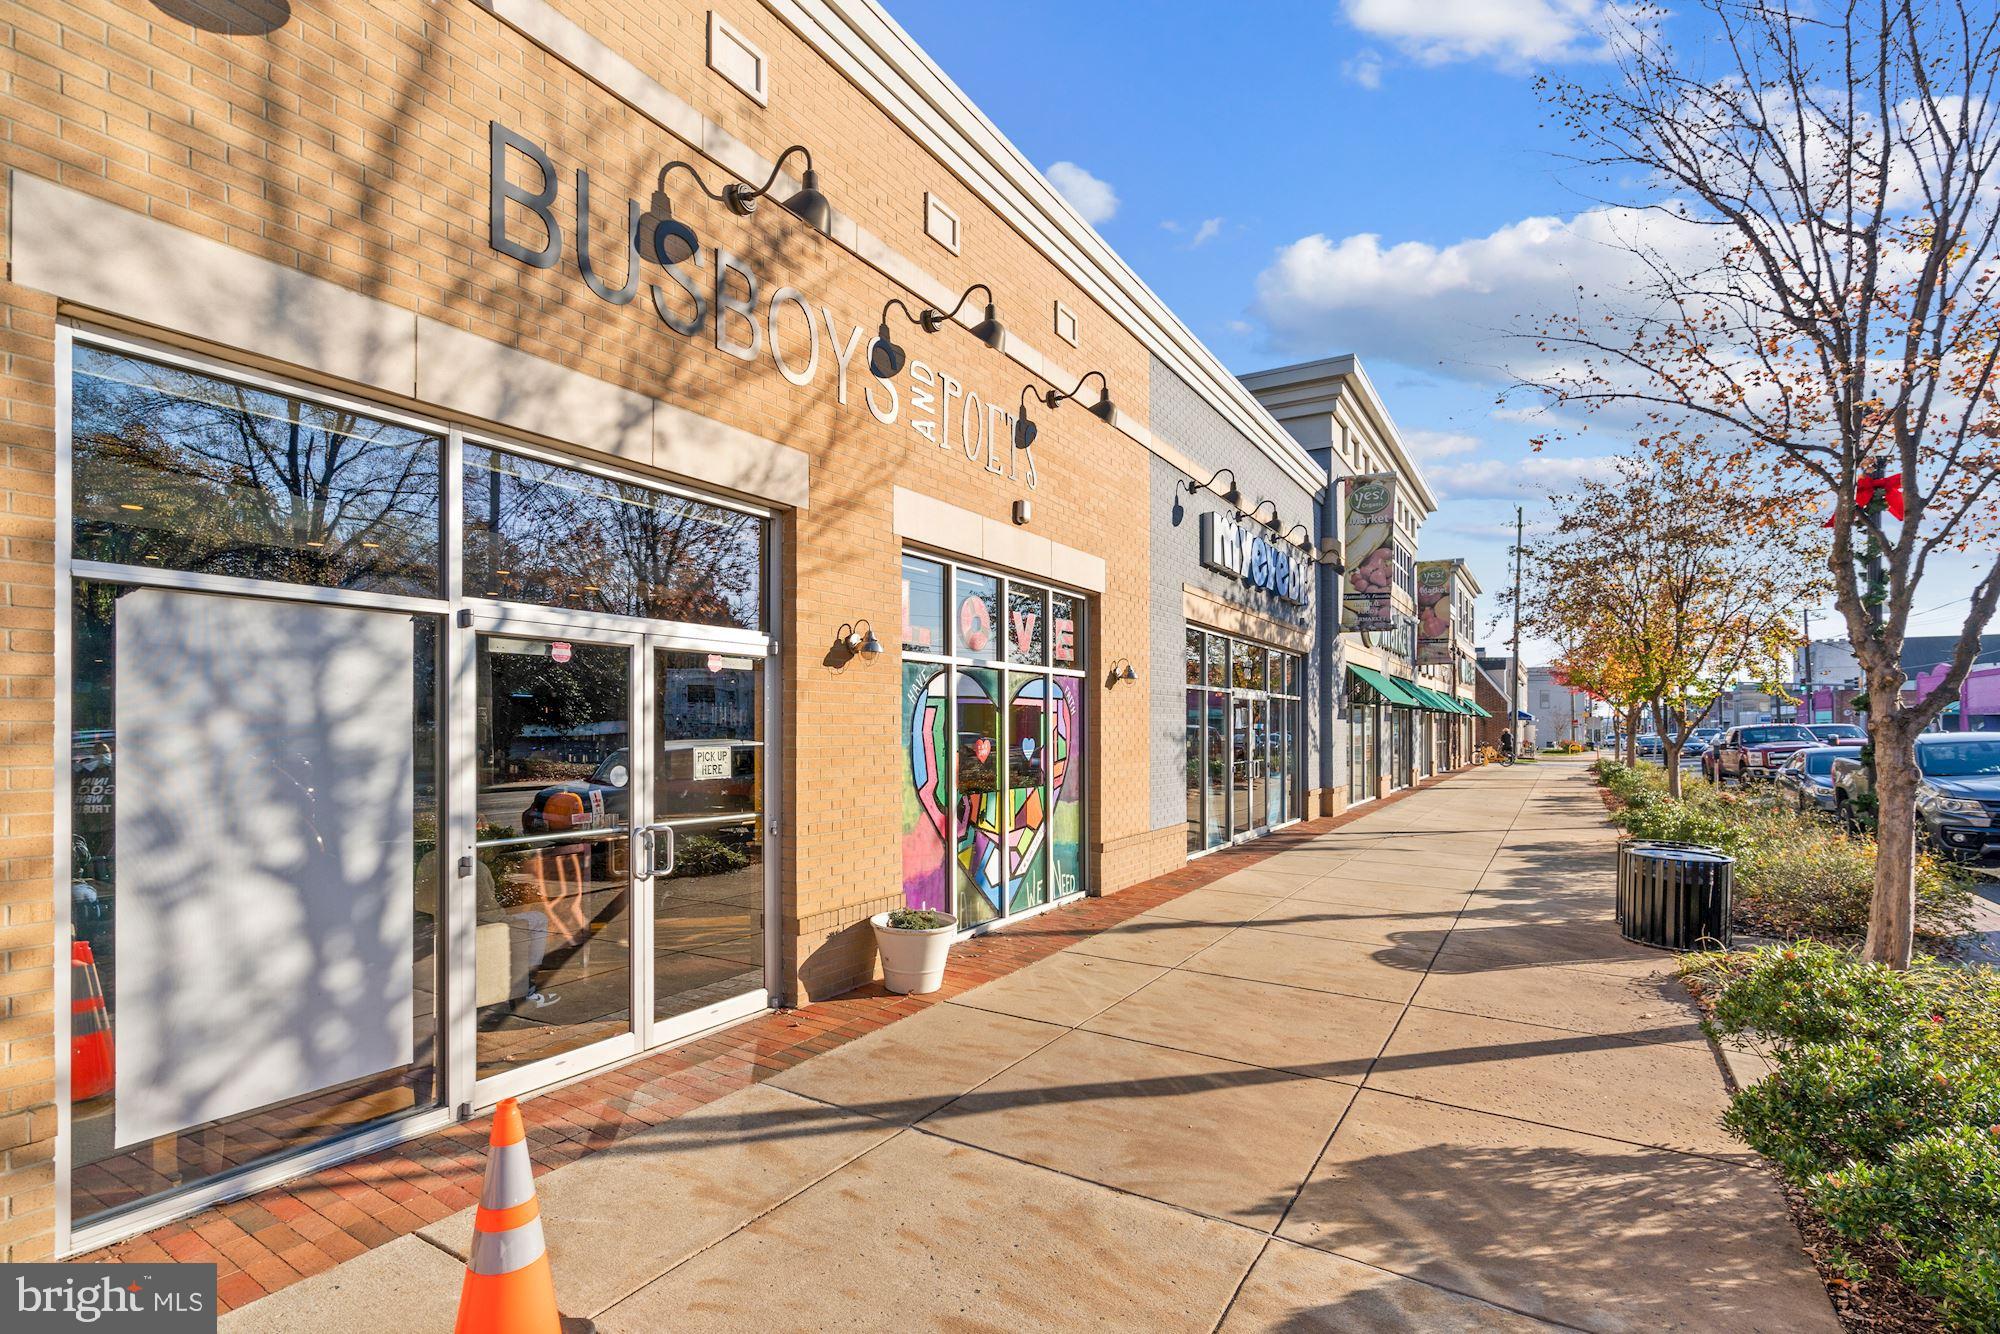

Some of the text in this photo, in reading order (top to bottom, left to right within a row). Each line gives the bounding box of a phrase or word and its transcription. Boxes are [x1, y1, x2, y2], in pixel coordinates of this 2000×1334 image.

[490, 120, 1038, 490] BUSBOYS AND POETS
[1355, 490, 1385, 509] yes!
[1350, 513, 1389, 525] Market
[901, 580, 1074, 661] LOVE
[908, 668, 930, 704] HAVE
[697, 751, 728, 762] PICK UP
[702, 764, 723, 775] HERE
[1052, 859, 1076, 899] NEED
